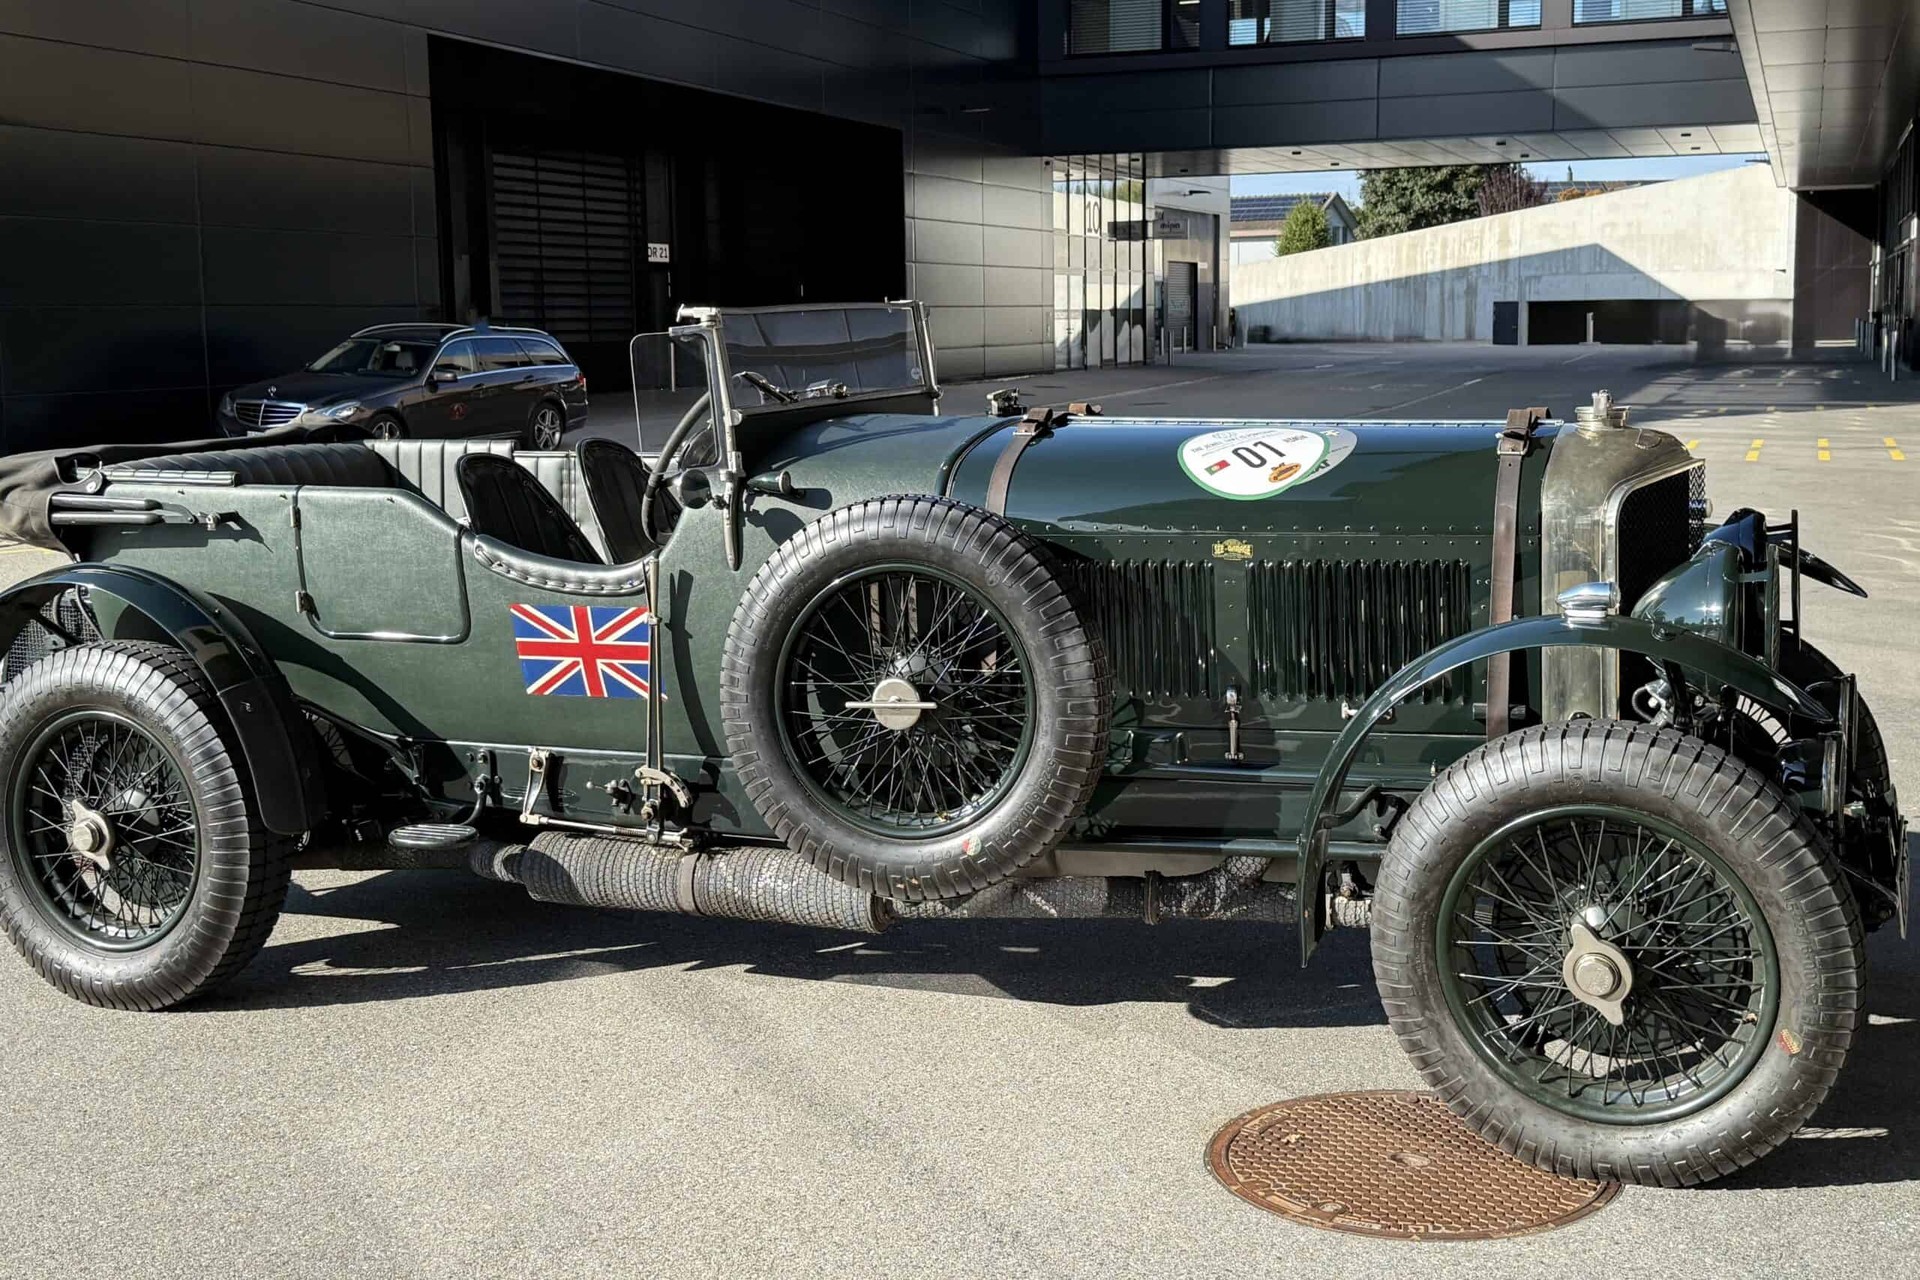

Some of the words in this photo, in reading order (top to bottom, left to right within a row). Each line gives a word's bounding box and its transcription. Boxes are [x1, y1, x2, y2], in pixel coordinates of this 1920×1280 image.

[1086, 201, 1100, 234] 10
[659, 247, 668, 258] 21
[1232, 441, 1286, 468] 01
